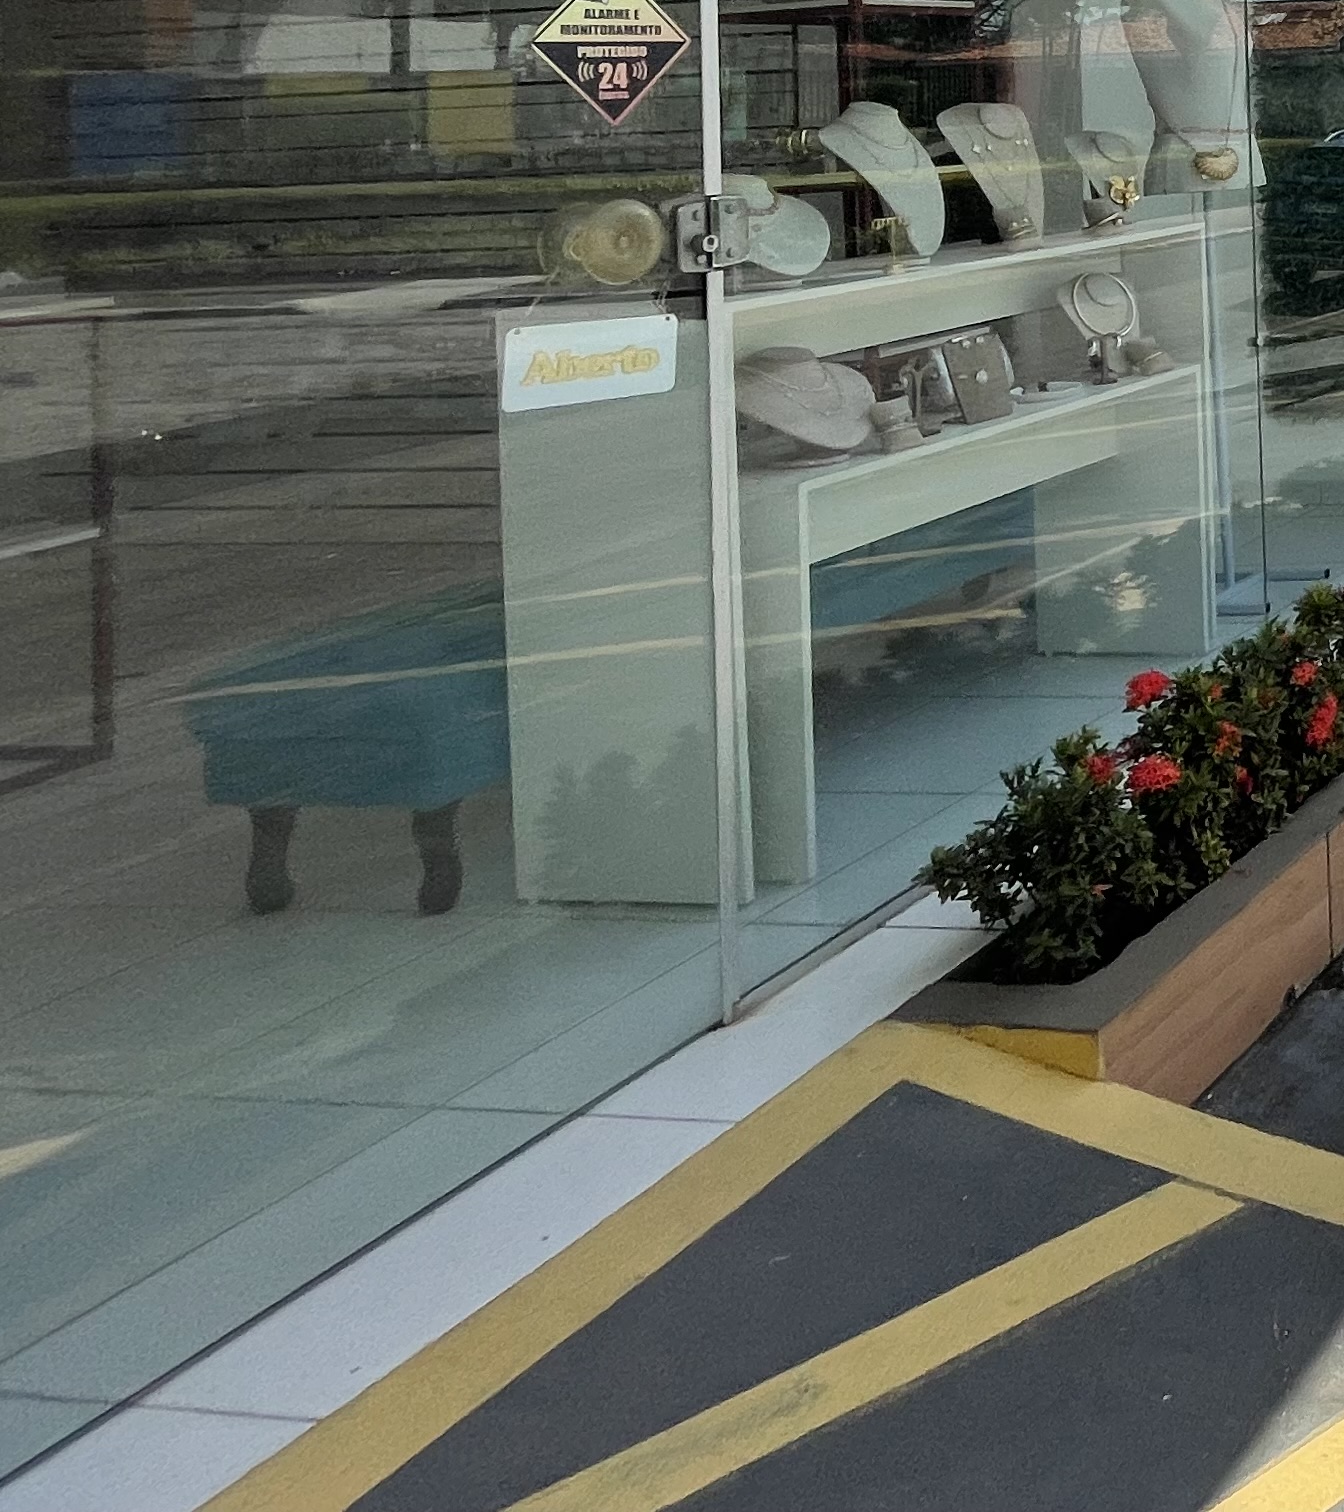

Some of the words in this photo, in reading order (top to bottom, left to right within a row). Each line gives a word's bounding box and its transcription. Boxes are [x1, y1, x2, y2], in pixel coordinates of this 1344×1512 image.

[583, 8, 631, 20] ALARME
[634, 8, 641, 20] E
[559, 24, 662, 36] MONITORAMENTO
[597, 61, 630, 90] 24
[520, 344, 660, 387] Aberto
